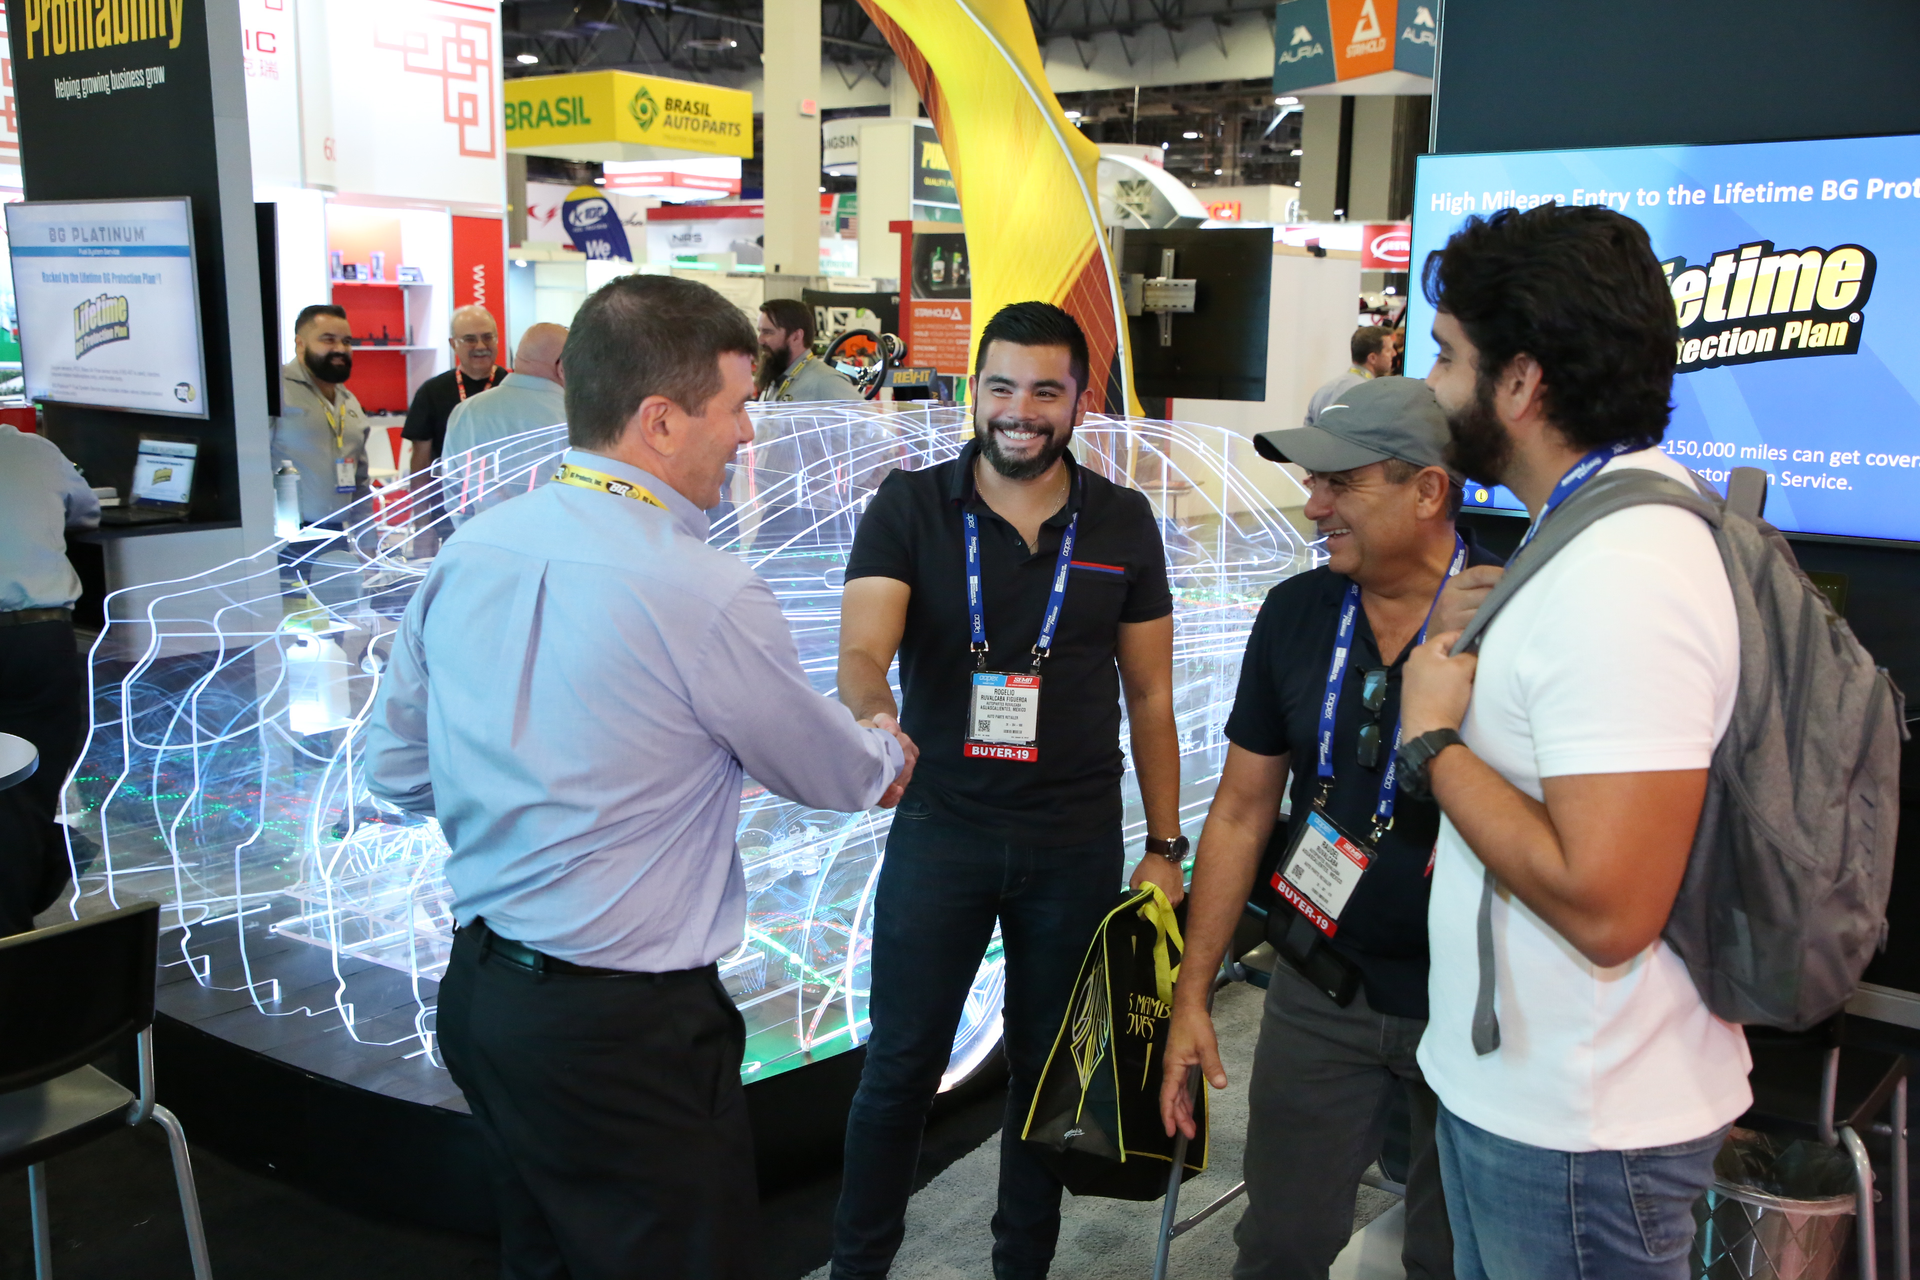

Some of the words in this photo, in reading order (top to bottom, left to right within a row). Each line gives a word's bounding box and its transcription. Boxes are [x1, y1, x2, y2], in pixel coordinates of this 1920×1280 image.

[1278, 43, 1324, 65] AURA
[54, 77, 81, 100] Helping
[81, 72, 111, 98] growing
[110, 68, 145, 90] business
[145, 65, 165, 88] grow
[505, 96, 591, 130] BRASIL
[665, 97, 711, 117] BRASIL
[1431, 192, 1475, 215] High
[1572, 189, 1631, 211] Entry
[1636, 188, 1660, 206] to
[1667, 184, 1706, 205] the
[1713, 182, 1814, 204] Lifetime
[1821, 179, 1859, 201] BG
[48, 227, 66, 242] BG
[71, 227, 145, 242] PLATINUM
[585, 239, 611, 259] We
[1740, 444, 1787, 461] miles
[1792, 448, 1824, 463] can
[1829, 450, 1860, 467] get
[1865, 452, 1920, 468] cover
[1781, 471, 1853, 491] Service.
[971, 746, 1030, 760] BUYER-19
[1276, 880, 1329, 930] BUYER-19
